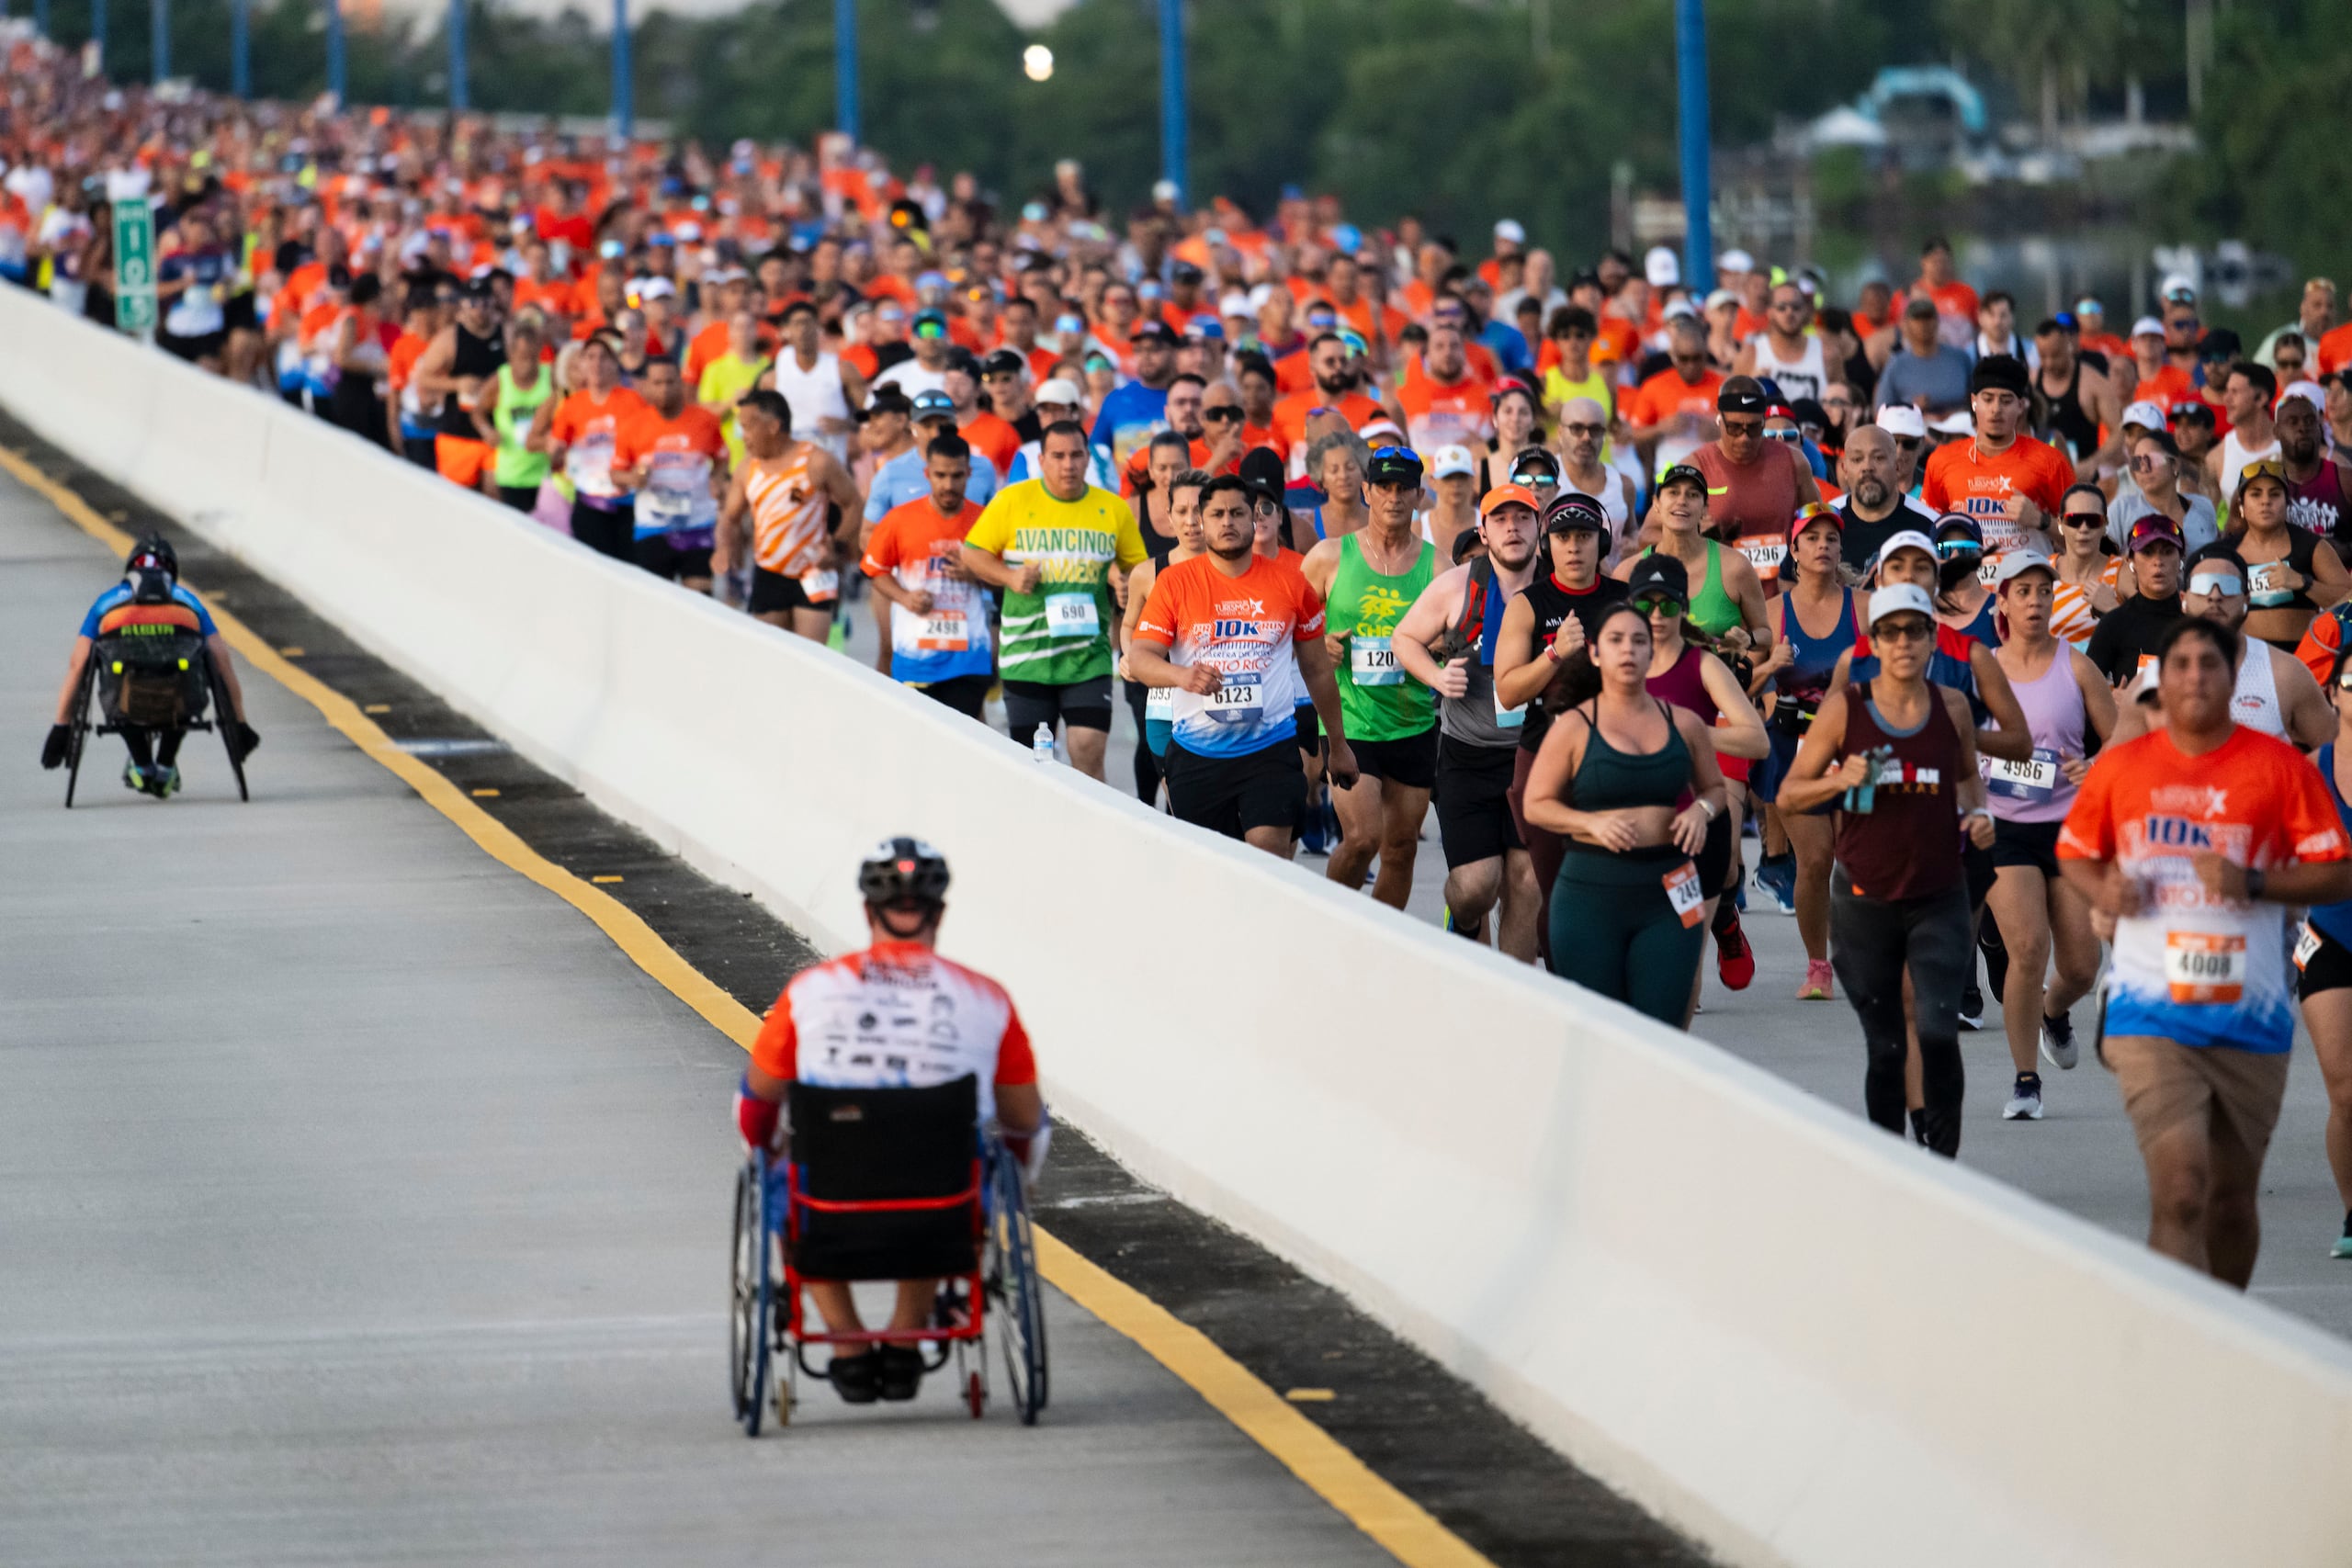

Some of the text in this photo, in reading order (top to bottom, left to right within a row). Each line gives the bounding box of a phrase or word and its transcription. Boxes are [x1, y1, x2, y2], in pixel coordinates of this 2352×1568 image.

[1967, 498, 2006, 514] 10K
[1015, 528, 1116, 558] AVANCINOS
[1062, 605, 1085, 619] 690
[927, 621, 959, 634] 2498
[1215, 619, 1260, 637] 10K
[1357, 623, 1394, 637] CHE
[1367, 650, 1394, 667] 120
[1214, 685, 1252, 705] 6123
[2004, 760, 2043, 780] 4986
[2147, 817, 2211, 848] 10K
[2179, 950, 2232, 976] 4008
